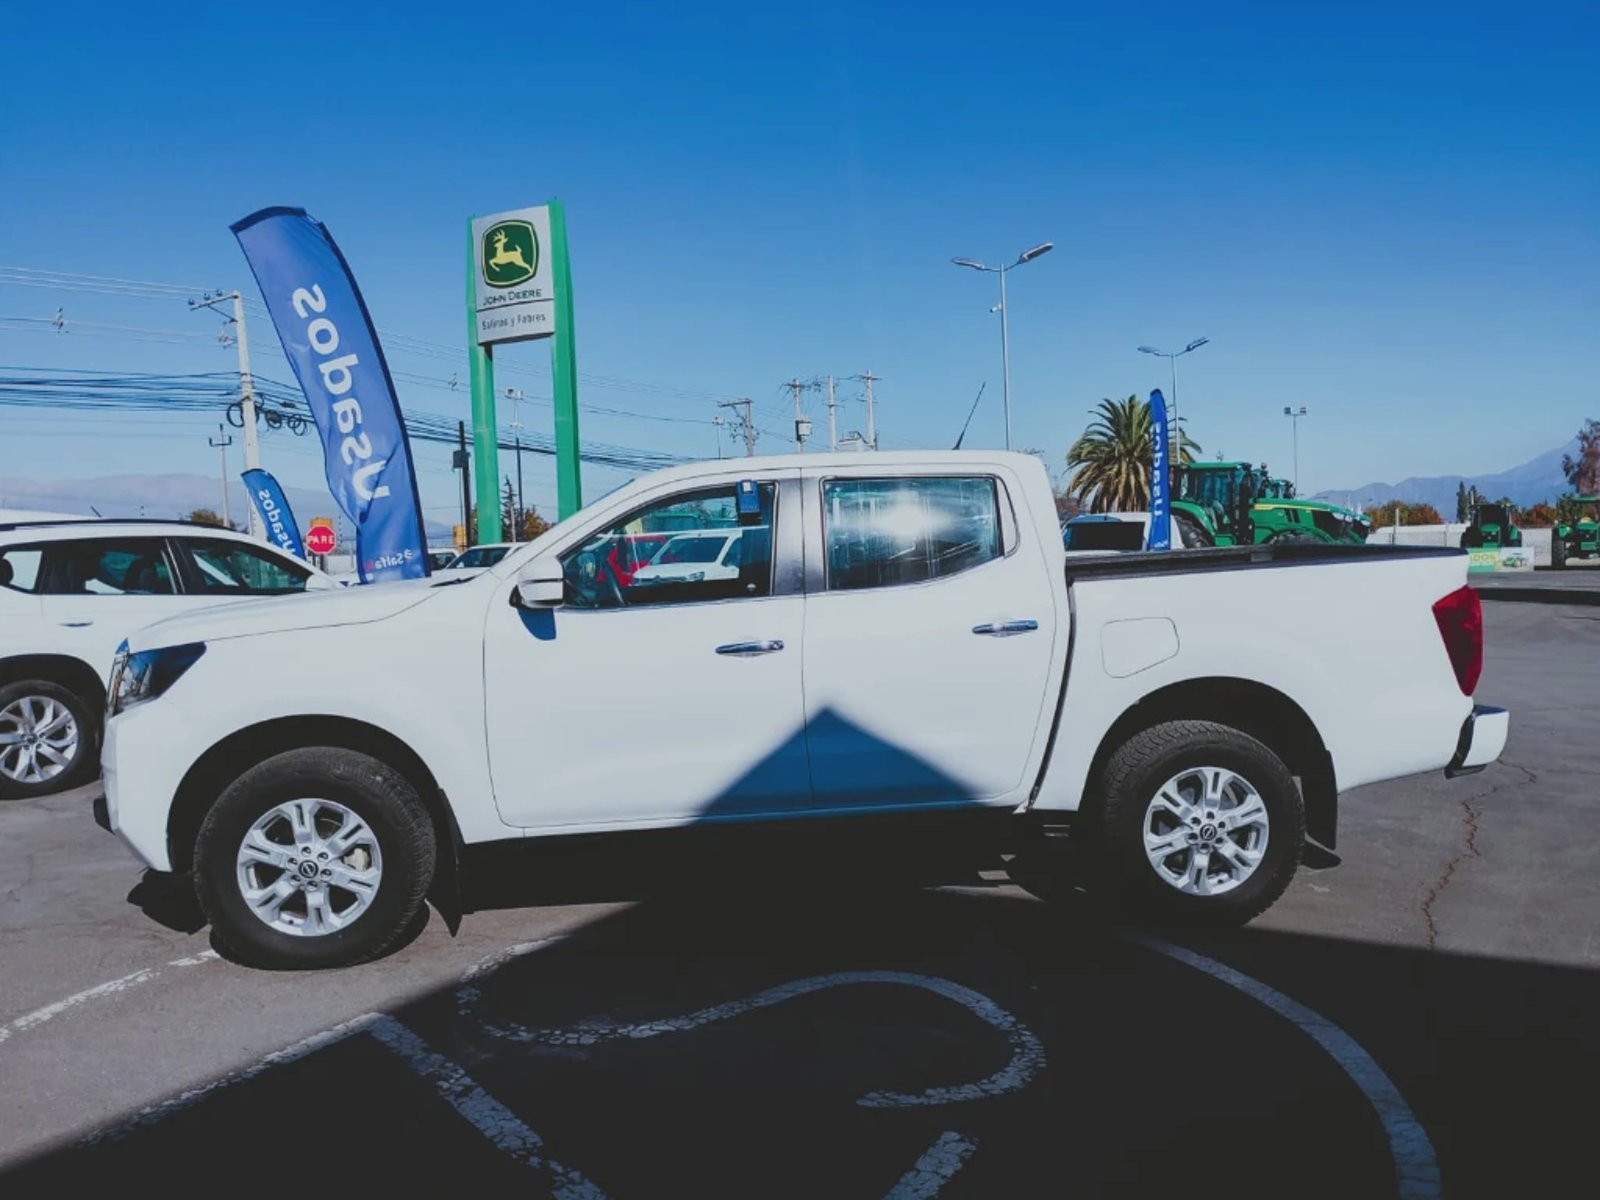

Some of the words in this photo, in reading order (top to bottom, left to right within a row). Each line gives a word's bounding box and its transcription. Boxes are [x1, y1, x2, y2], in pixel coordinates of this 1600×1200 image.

[482, 294, 507, 306] JOHN
[508, 288, 542, 300] DEERE
[308, 535, 334, 544] PARE
